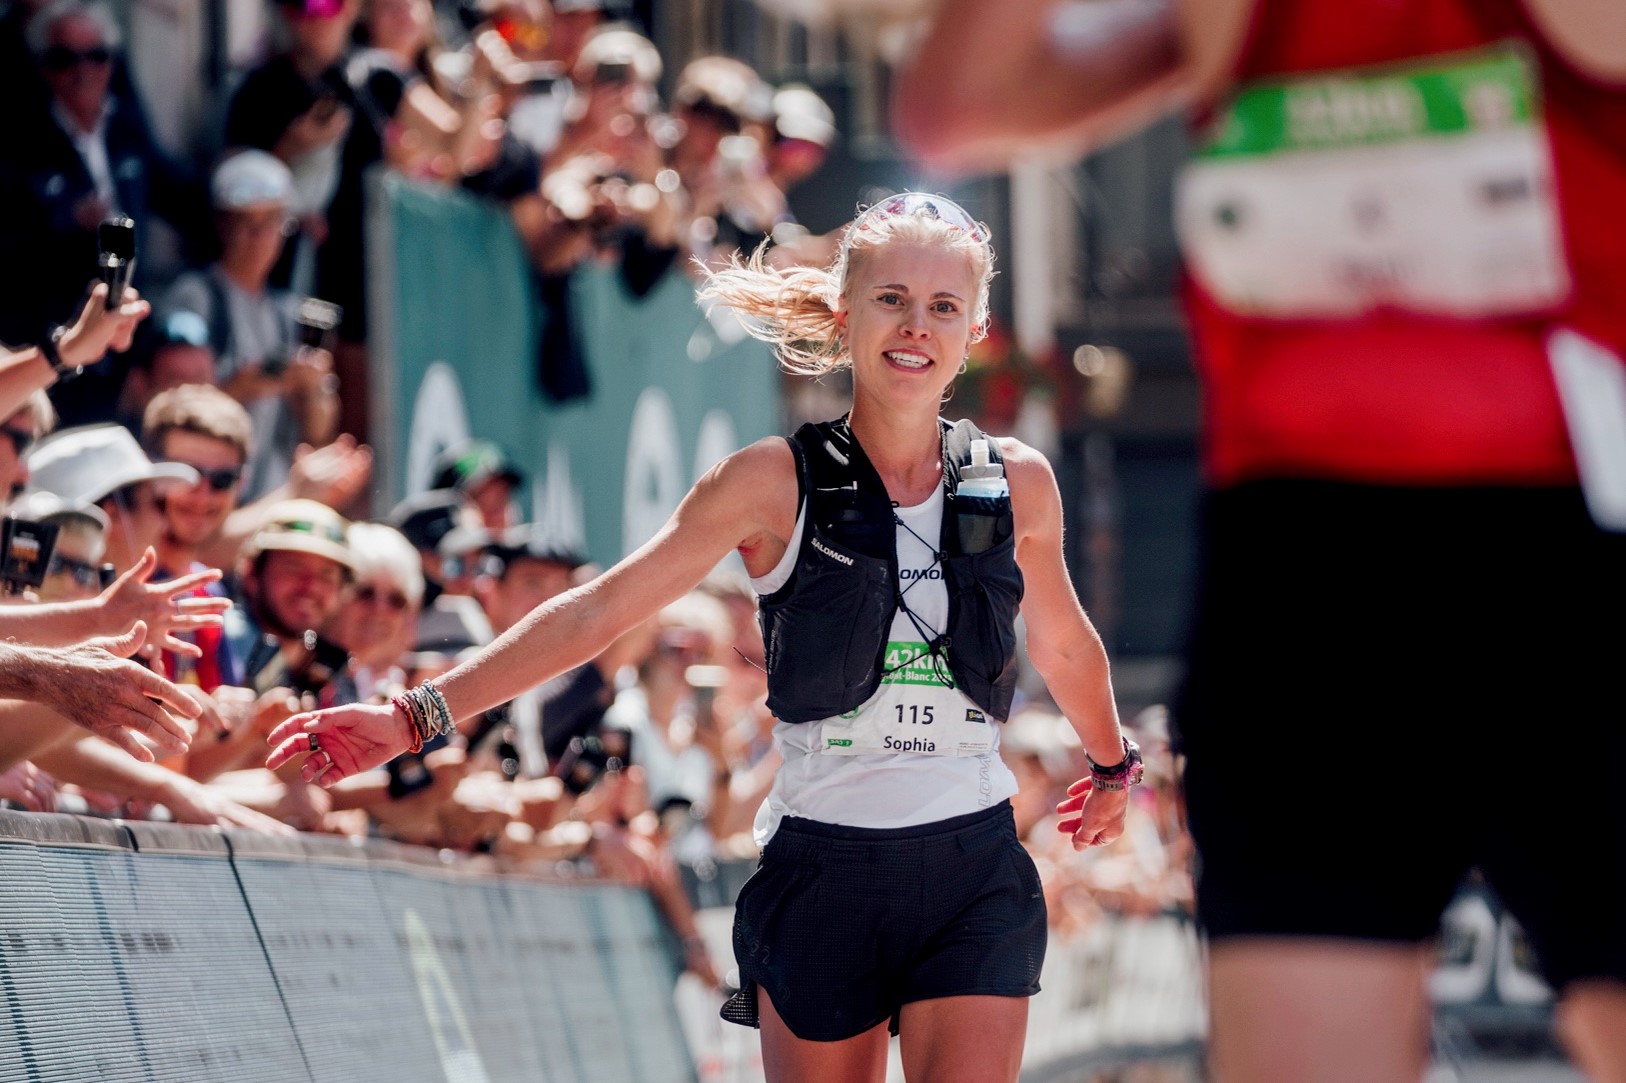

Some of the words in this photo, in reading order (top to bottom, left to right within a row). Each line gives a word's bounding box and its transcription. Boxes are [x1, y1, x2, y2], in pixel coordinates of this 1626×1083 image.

[810, 537, 855, 567] SALOMON
[899, 568, 944, 580] OMO
[894, 703, 935, 726] 115
[883, 735, 936, 753] Sophia
